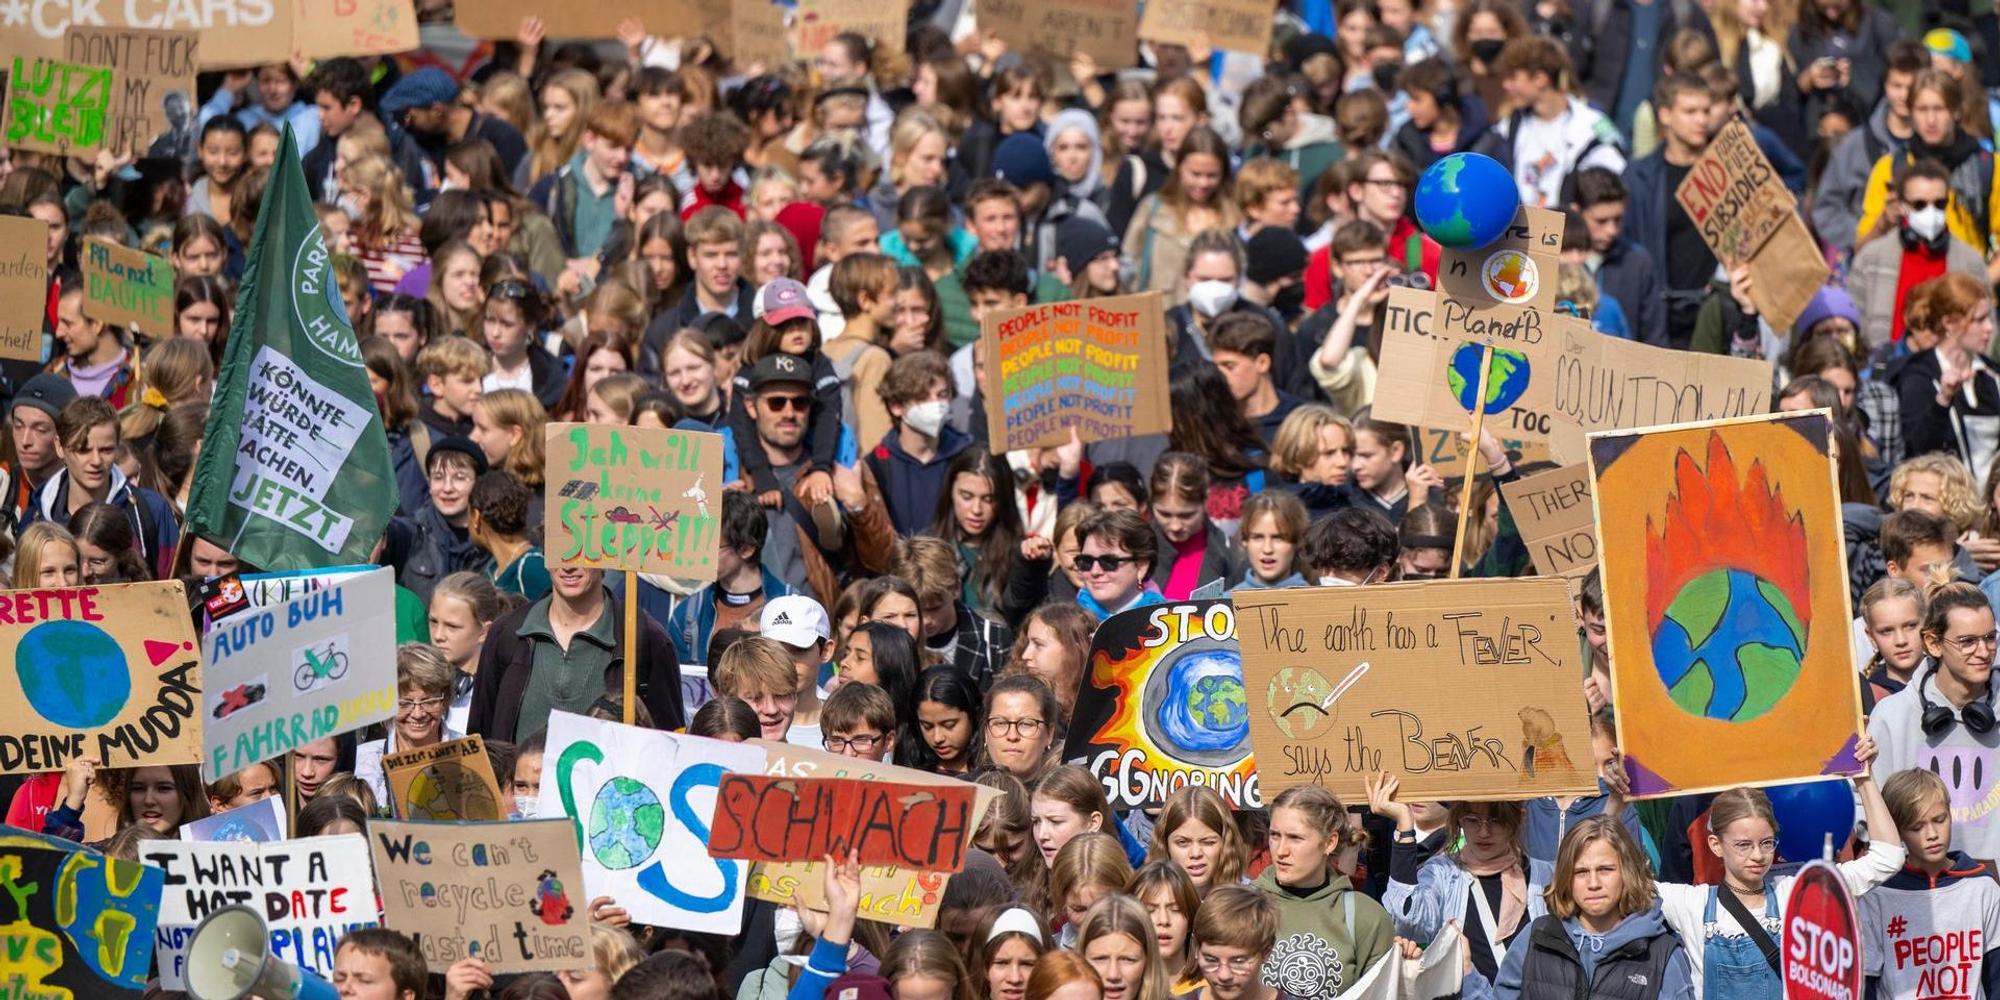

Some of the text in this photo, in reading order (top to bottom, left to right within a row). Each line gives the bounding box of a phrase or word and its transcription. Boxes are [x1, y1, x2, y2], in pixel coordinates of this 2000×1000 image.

[123, 0, 275, 29] CARS
[144, 35, 198, 77] FUCK
[125, 77, 150, 114] MY
[1725, 140, 1757, 177] FUEL
[1681, 159, 1728, 223] END
[1704, 155, 1771, 248] SUBSIDIES
[1541, 226, 1560, 247] is
[998, 304, 1140, 341] PEOPLE NOT PROFIT
[1000, 319, 1141, 358] PEOPLE NOT PROFIT
[1442, 300, 1525, 340] Planet
[775, 355, 795, 372] KC
[1001, 337, 1140, 380] PEOPLE NOT PROFIT
[249, 381, 322, 442] WÜRDE
[257, 361, 346, 428] KÖNNTE
[1006, 392, 1133, 430] PEOPLE NOT PROFIT
[1007, 415, 1056, 450] PEOPLE
[1085, 417, 1134, 439] PROFIT
[238, 432, 315, 493] ACHEN.
[1517, 479, 1592, 522] THER
[0, 588, 104, 624] RETTE
[1144, 603, 1237, 648] STO
[212, 611, 275, 666] AUTO
[1324, 604, 1377, 653] earth
[1386, 611, 1417, 650] has
[1426, 623, 1439, 648] a
[0, 733, 86, 770] DEINE
[212, 704, 341, 778] FAHRRAD
[1283, 708, 1519, 786] says the BEAVER
[386, 754, 404, 770] DIE
[712, 777, 968, 870] SCHWACH
[145, 851, 328, 886] I WANT A
[378, 832, 540, 868] We can't
[264, 888, 349, 922] DATE
[400, 876, 525, 925] recycle
[512, 920, 586, 961] time
[1789, 915, 1854, 982] STOP
[1893, 930, 1982, 970] PEOPLE
[1916, 962, 1973, 998] NOT
